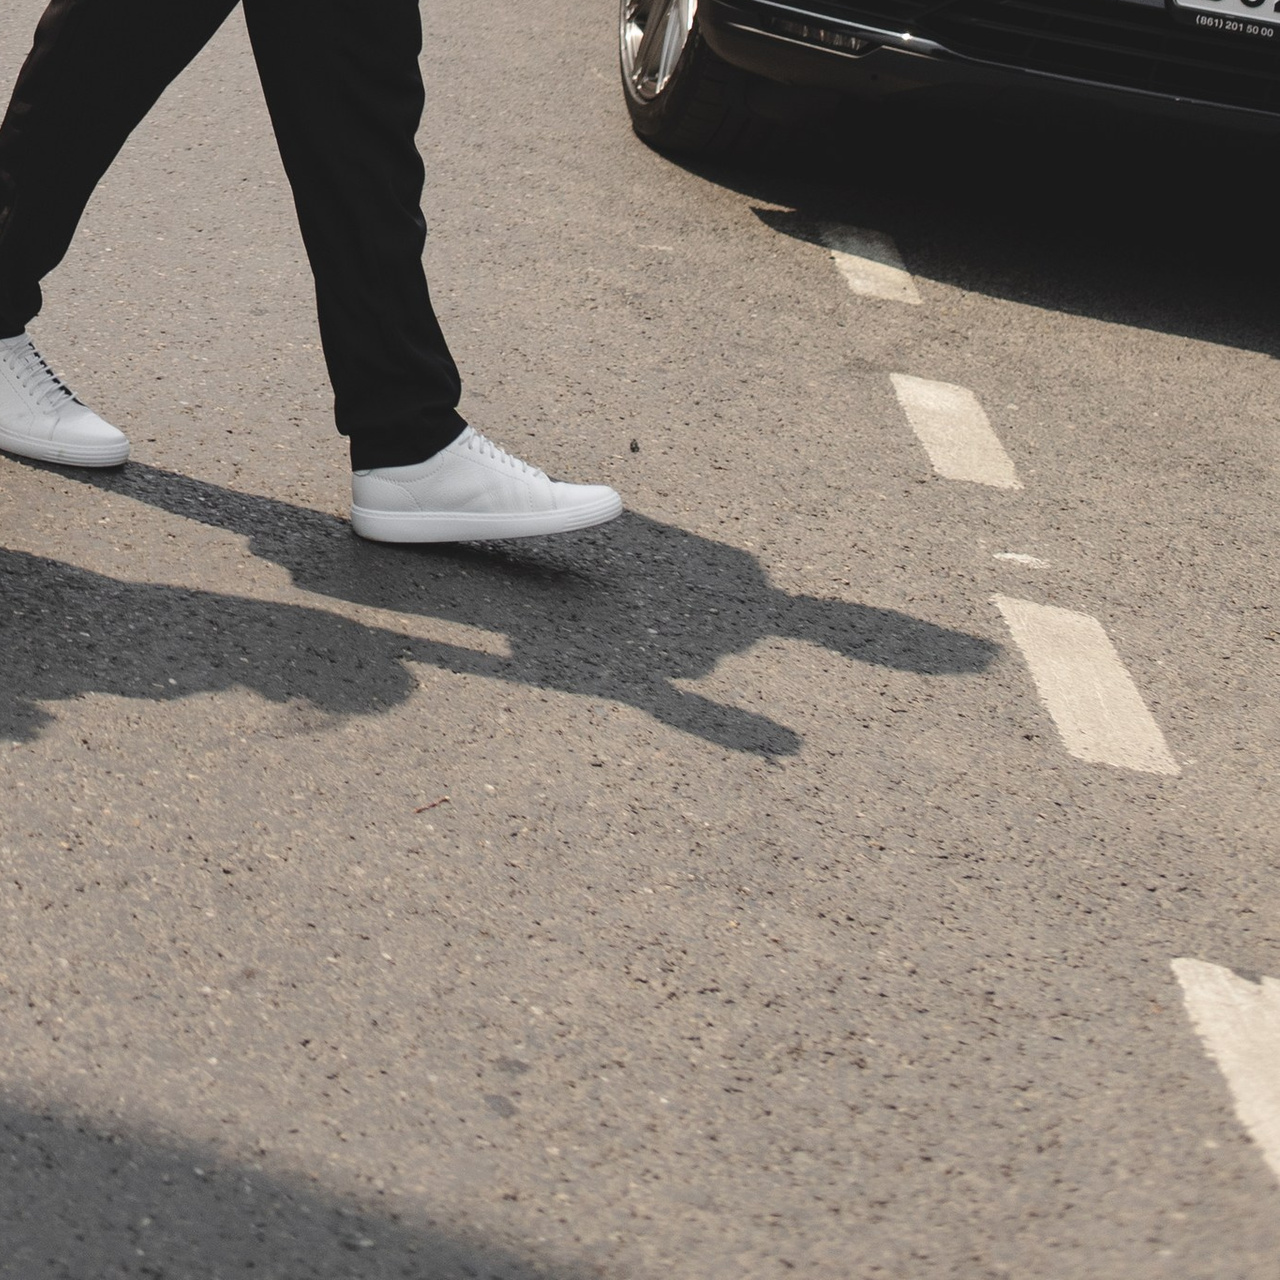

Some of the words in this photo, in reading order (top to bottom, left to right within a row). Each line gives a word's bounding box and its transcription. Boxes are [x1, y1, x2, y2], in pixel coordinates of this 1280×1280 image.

[1195, 14, 1224, 29] (861)
[1225, 20, 1244, 32] 201
[1246, 24, 1260, 35] 50
[1261, 26, 1274, 38] 00
